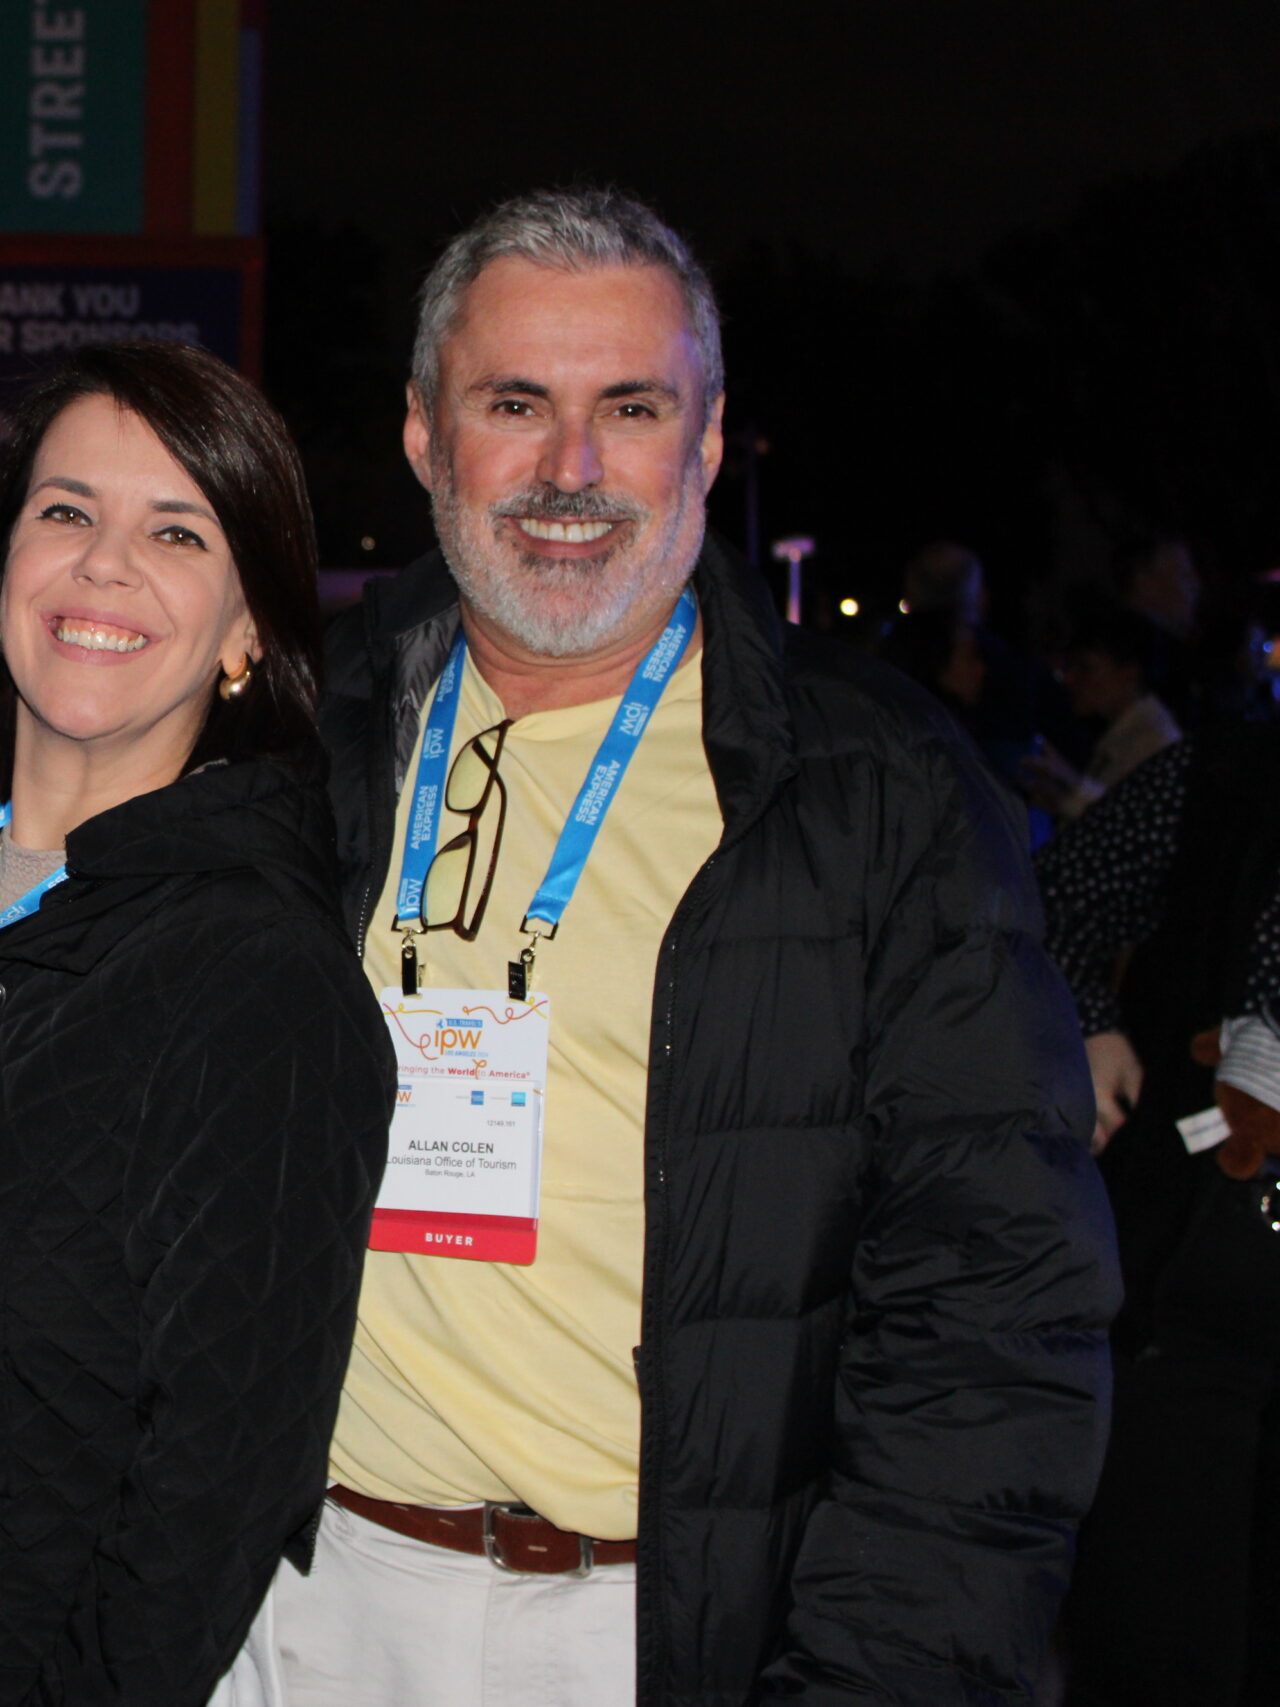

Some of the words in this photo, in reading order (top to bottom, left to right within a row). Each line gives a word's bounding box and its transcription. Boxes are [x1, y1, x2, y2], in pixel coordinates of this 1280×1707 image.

[26, 0, 87, 199] STREE
[71, 283, 140, 318] YOU
[642, 627, 674, 679] EXPRESS
[652, 624, 687, 682] AMERICAN
[620, 702, 642, 736] ipw
[430, 728, 445, 759] ipw
[576, 765, 607, 822] EXPRESS
[585, 760, 621, 826] AMERICAN
[410, 785, 428, 850] AMERICAN
[422, 784, 438, 841] EXPRESS
[434, 1029, 482, 1056] ipw
[397, 1064, 429, 1076] ringing
[431, 1066, 445, 1074] the
[448, 1067, 475, 1076] World
[408, 1140, 448, 1152] ALLAN
[452, 1142, 494, 1154] COLEN
[435, 1156, 463, 1168] Office
[466, 1158, 476, 1168] of
[479, 1158, 517, 1170] Tourism
[425, 1232, 473, 1246] BUYER
